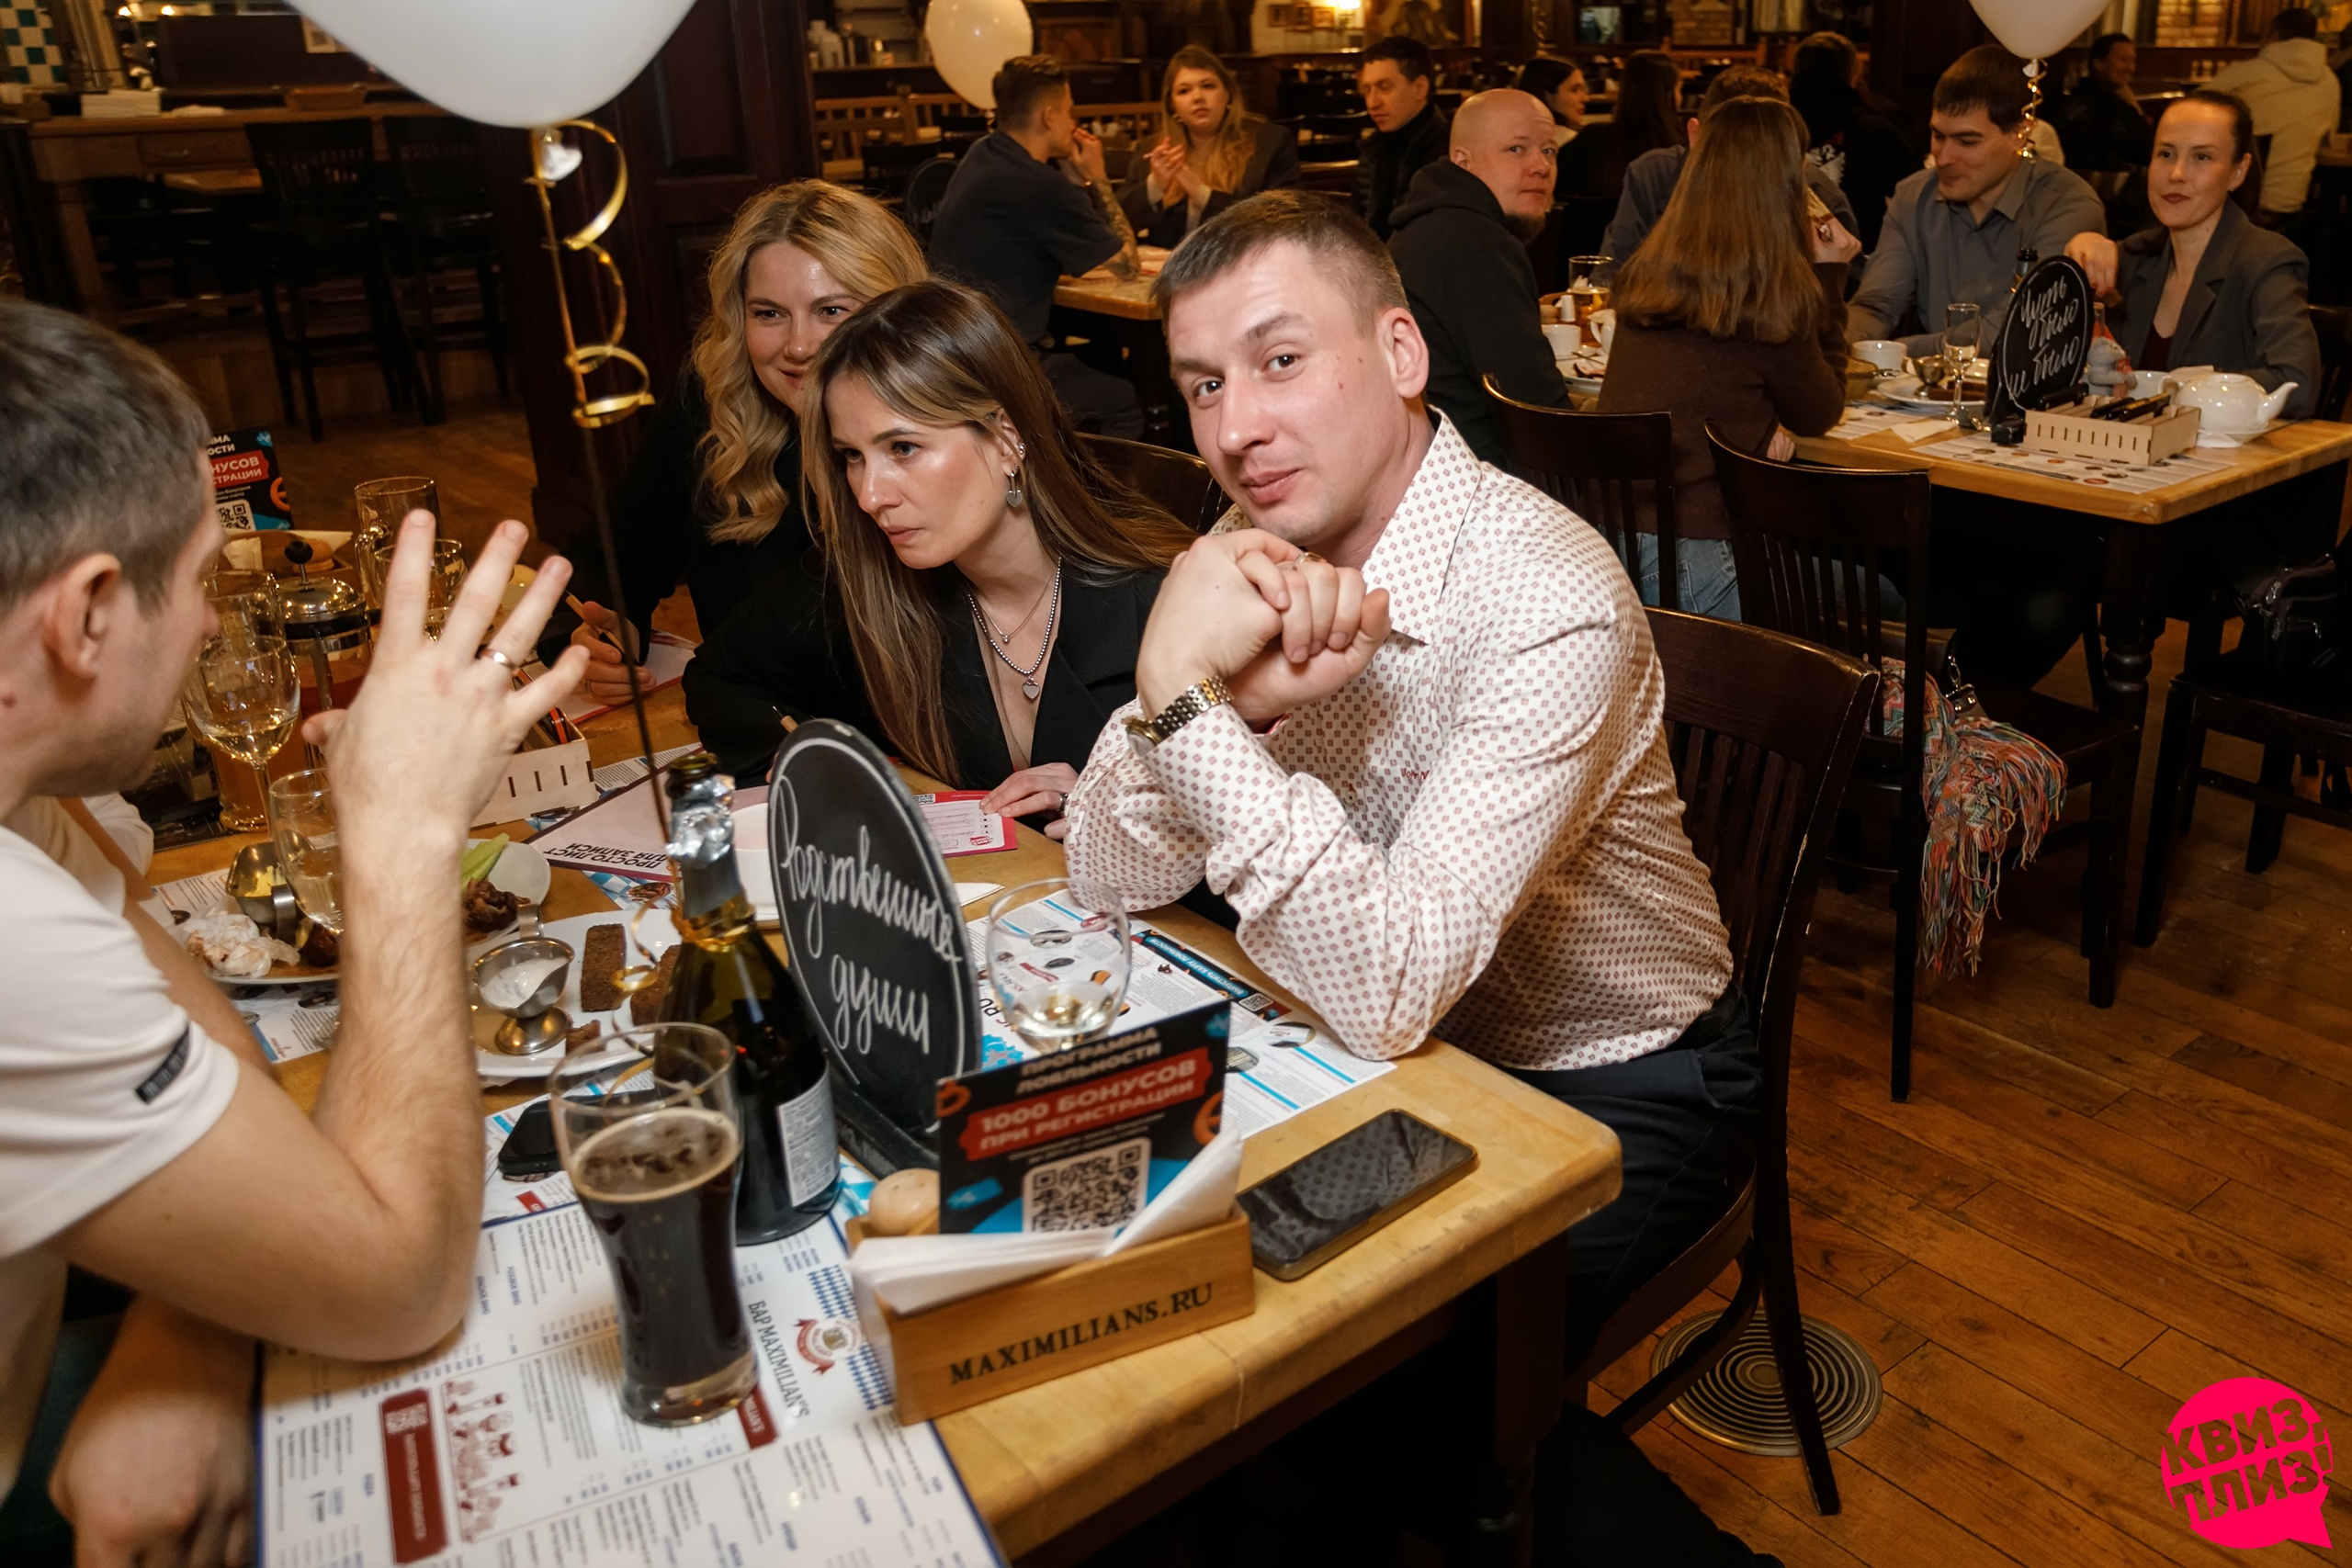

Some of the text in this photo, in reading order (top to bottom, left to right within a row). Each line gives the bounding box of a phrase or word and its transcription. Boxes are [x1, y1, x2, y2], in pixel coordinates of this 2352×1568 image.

[543, 847, 662, 869] ПРОСТО ЛИСТ
[565, 842, 635, 857] ЗАПИСИ
[1016, 1042, 1162, 1094] ЛОЯЛЬНОСТИ
[980, 1102, 1049, 1133] 1000
[1057, 1058, 1197, 1112] БОНУСОВ
[980, 1128, 1029, 1150] ПРИ
[1035, 1079, 1194, 1135] РЕГИСТРАЦИИ
[748, 1300, 772, 1325] БАР
[949, 1282, 1213, 1385] MAXIMILIANS.RU
